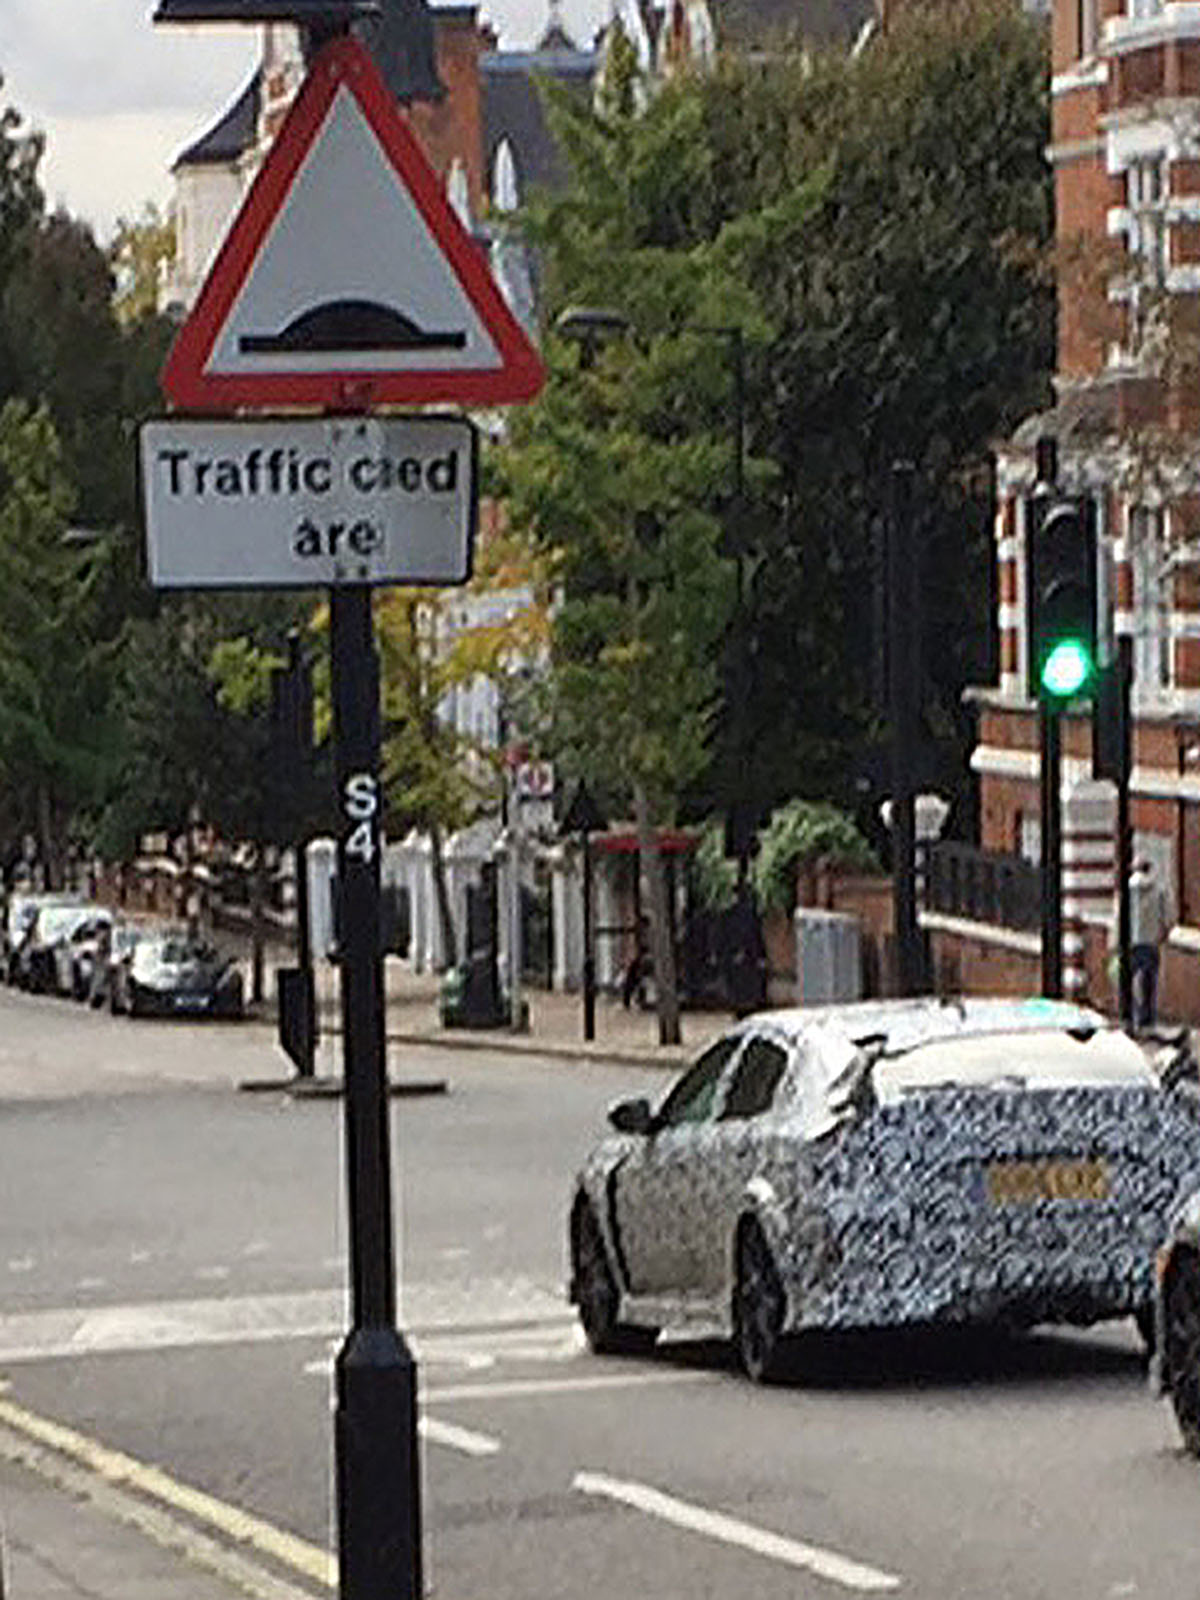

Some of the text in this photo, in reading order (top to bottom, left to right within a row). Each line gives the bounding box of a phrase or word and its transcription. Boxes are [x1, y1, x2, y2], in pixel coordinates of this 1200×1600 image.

[159, 448, 332, 496] Traffic
[294, 518, 377, 558] are
[345, 774, 377, 820] S
[345, 820, 376, 864] 4
